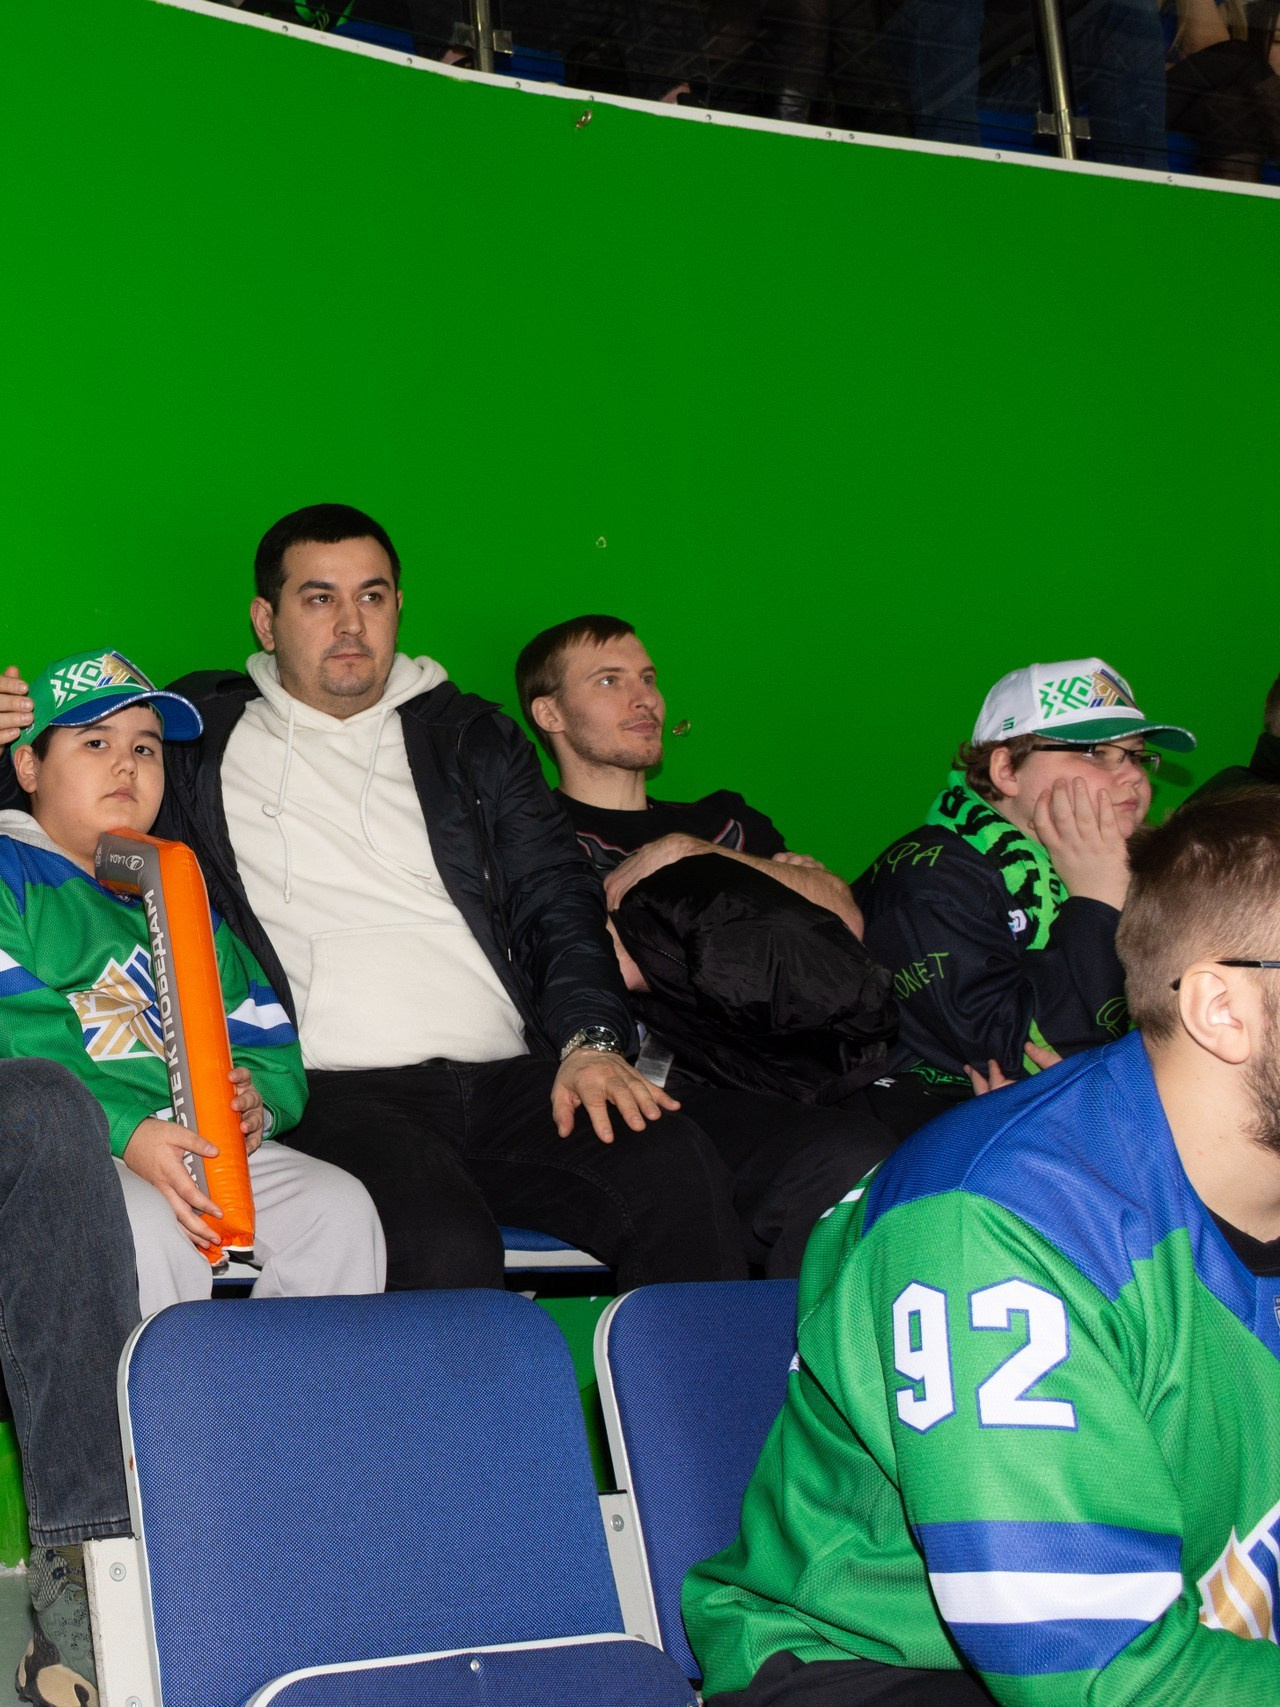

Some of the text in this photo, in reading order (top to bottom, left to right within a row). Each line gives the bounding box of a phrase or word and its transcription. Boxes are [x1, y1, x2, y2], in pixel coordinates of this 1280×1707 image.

[109, 853, 126, 863] LADA
[144, 889, 176, 1041] ПОБЕДАМ
[165, 1043, 179, 1068] К
[891, 1276, 1078, 1434] 92
